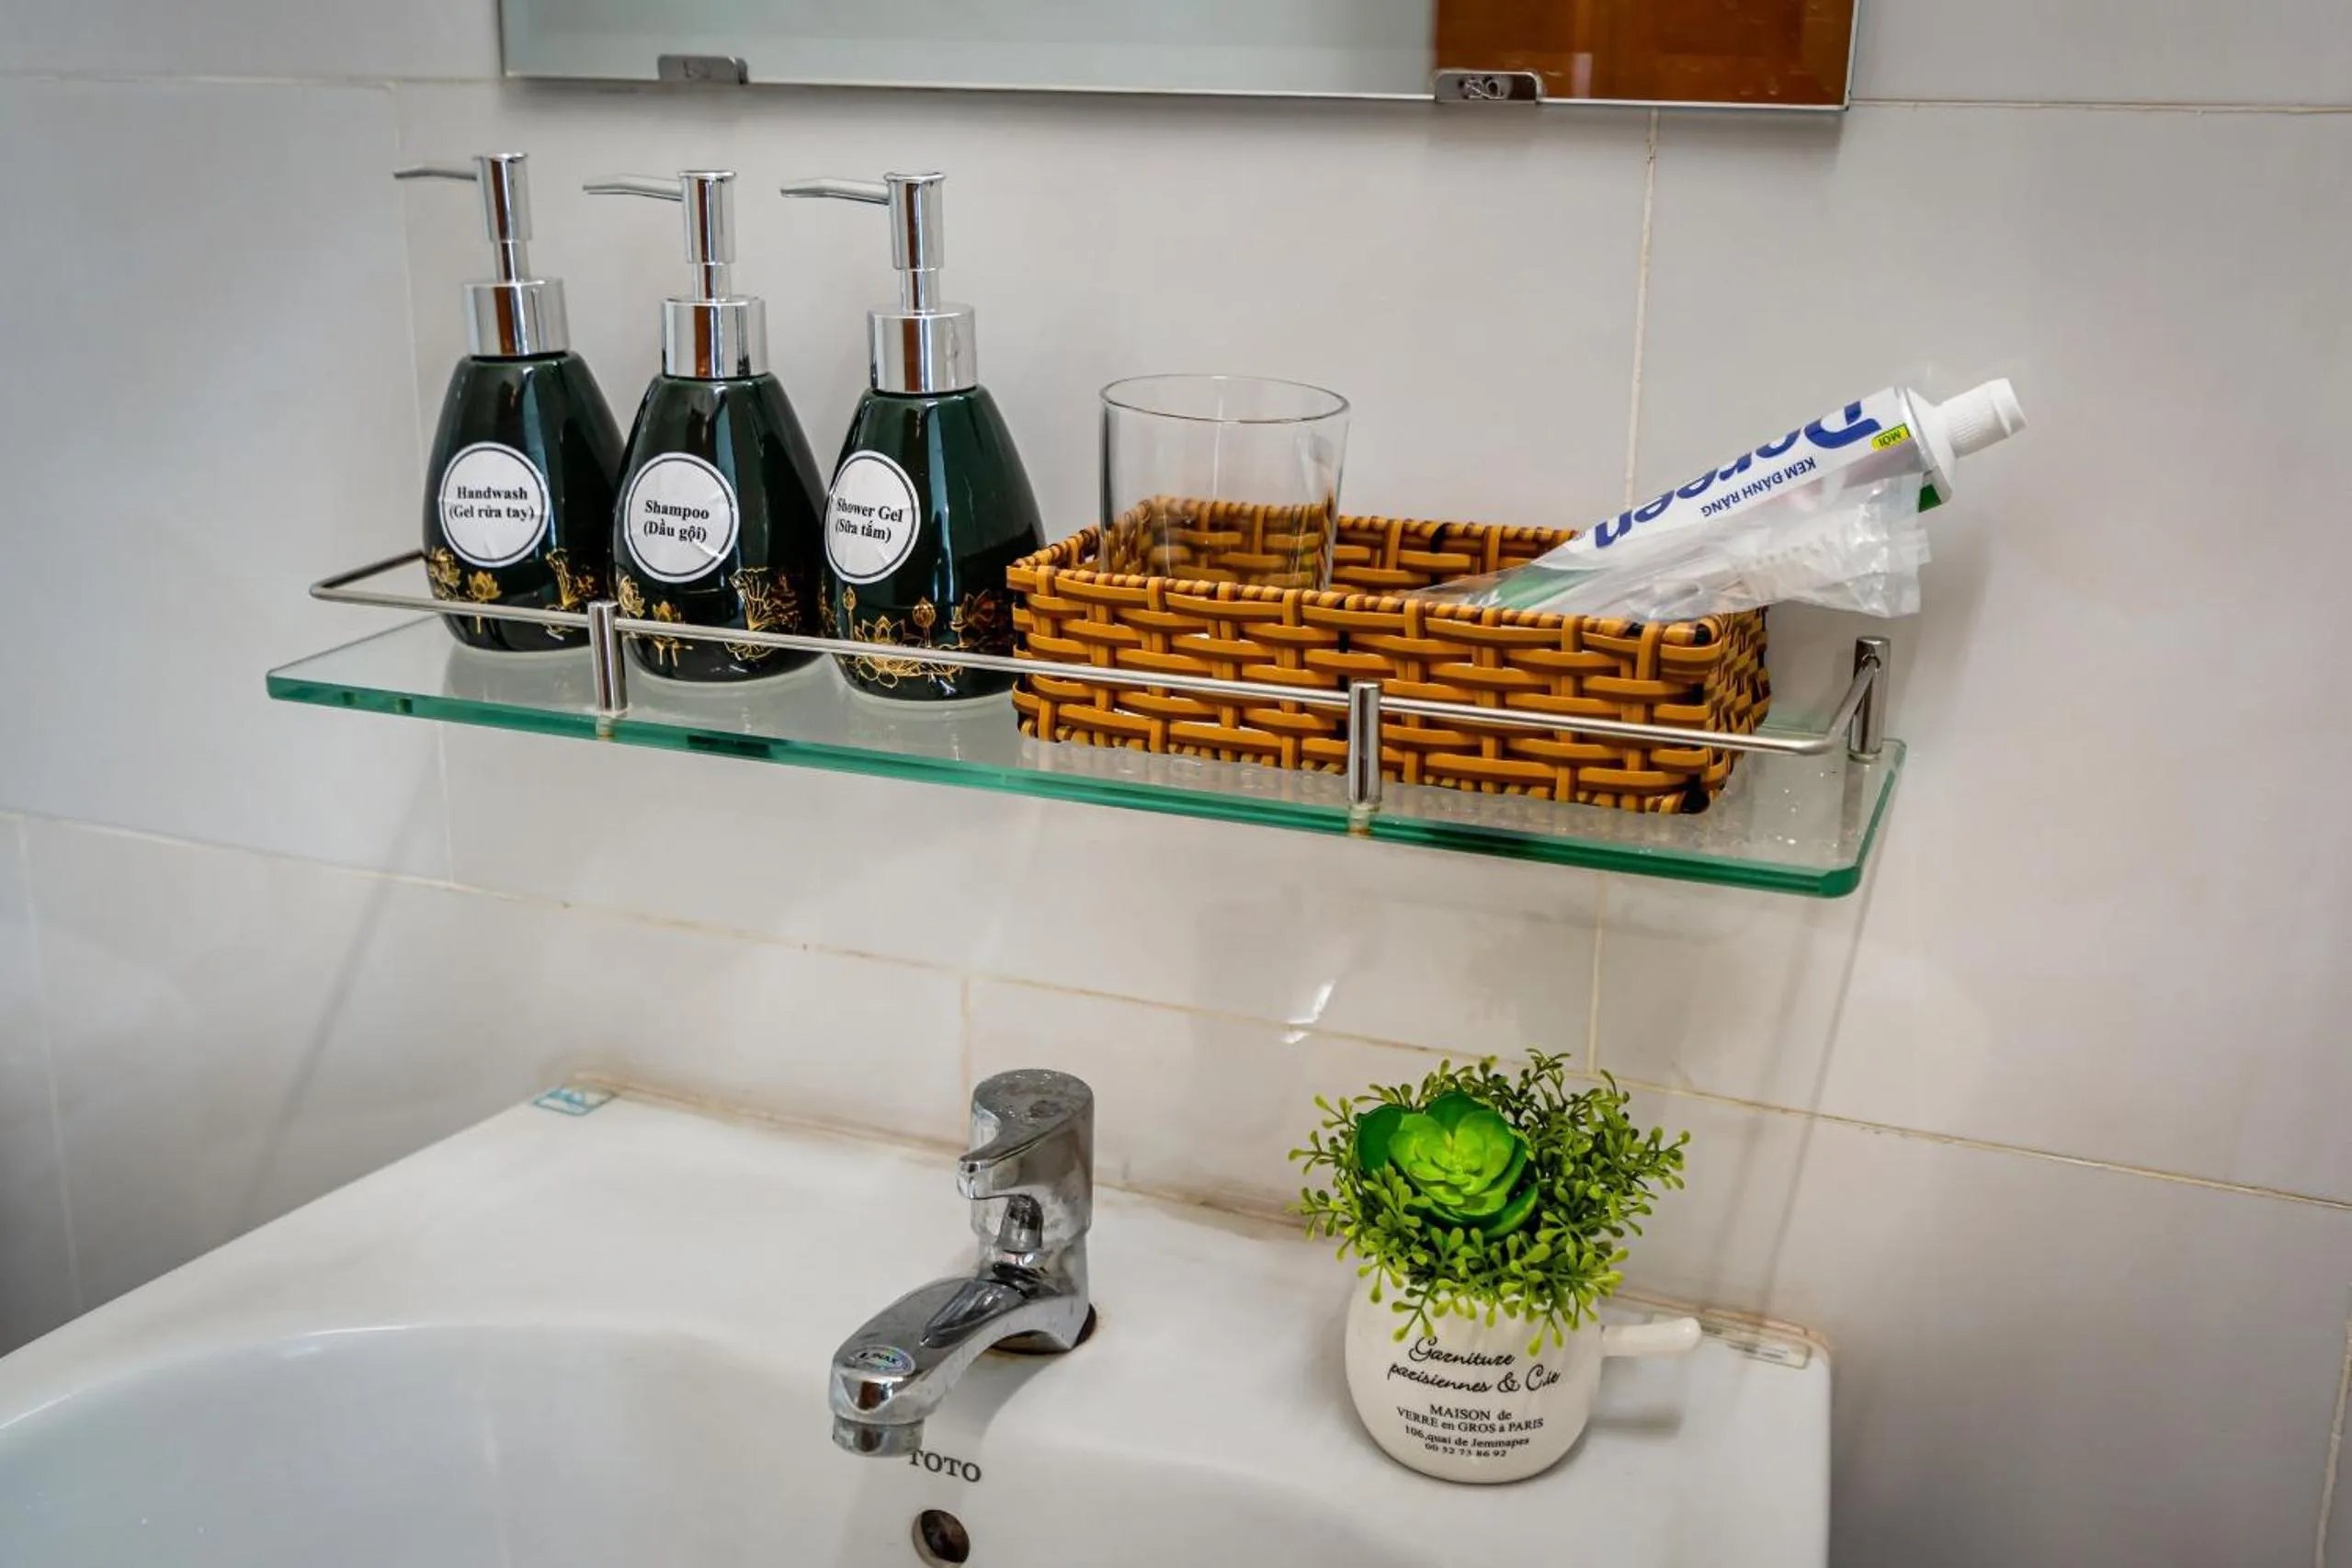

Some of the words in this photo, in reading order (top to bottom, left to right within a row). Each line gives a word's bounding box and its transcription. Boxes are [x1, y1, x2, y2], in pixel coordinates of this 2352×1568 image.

[1783, 457, 1816, 479] KEM
[457, 486, 528, 500] Handwash
[1741, 472, 1783, 499] ĐÁNH
[449, 506, 474, 520] (Gel
[477, 505, 502, 518] rửa
[506, 506, 535, 521] tay)
[644, 499, 710, 521] Shampoo
[836, 497, 875, 517] Shower
[878, 506, 903, 523] Gel
[1700, 491, 1740, 517] RĂNG
[643, 518, 675, 539] (Dầu
[678, 526, 707, 543] gội)
[835, 518, 858, 535] (Sữa
[861, 520, 892, 544] tắm)
[1408, 1335, 1516, 1367] Garniture
[1497, 1370, 1521, 1393] &
[1396, 1406, 1439, 1427] VERRE
[1440, 1421, 1455, 1431] en
[1458, 1421, 1496, 1434] GROS
[1507, 1417, 1544, 1432] PARIS
[1429, 1403, 1491, 1421] MAISON
[1497, 1409, 1513, 1421] de
[1454, 1437, 1469, 1448] de
[1471, 1437, 1530, 1449] Jemmapes
[1493, 1449, 1507, 1458] 92
[909, 1449, 982, 1483] TOTO
